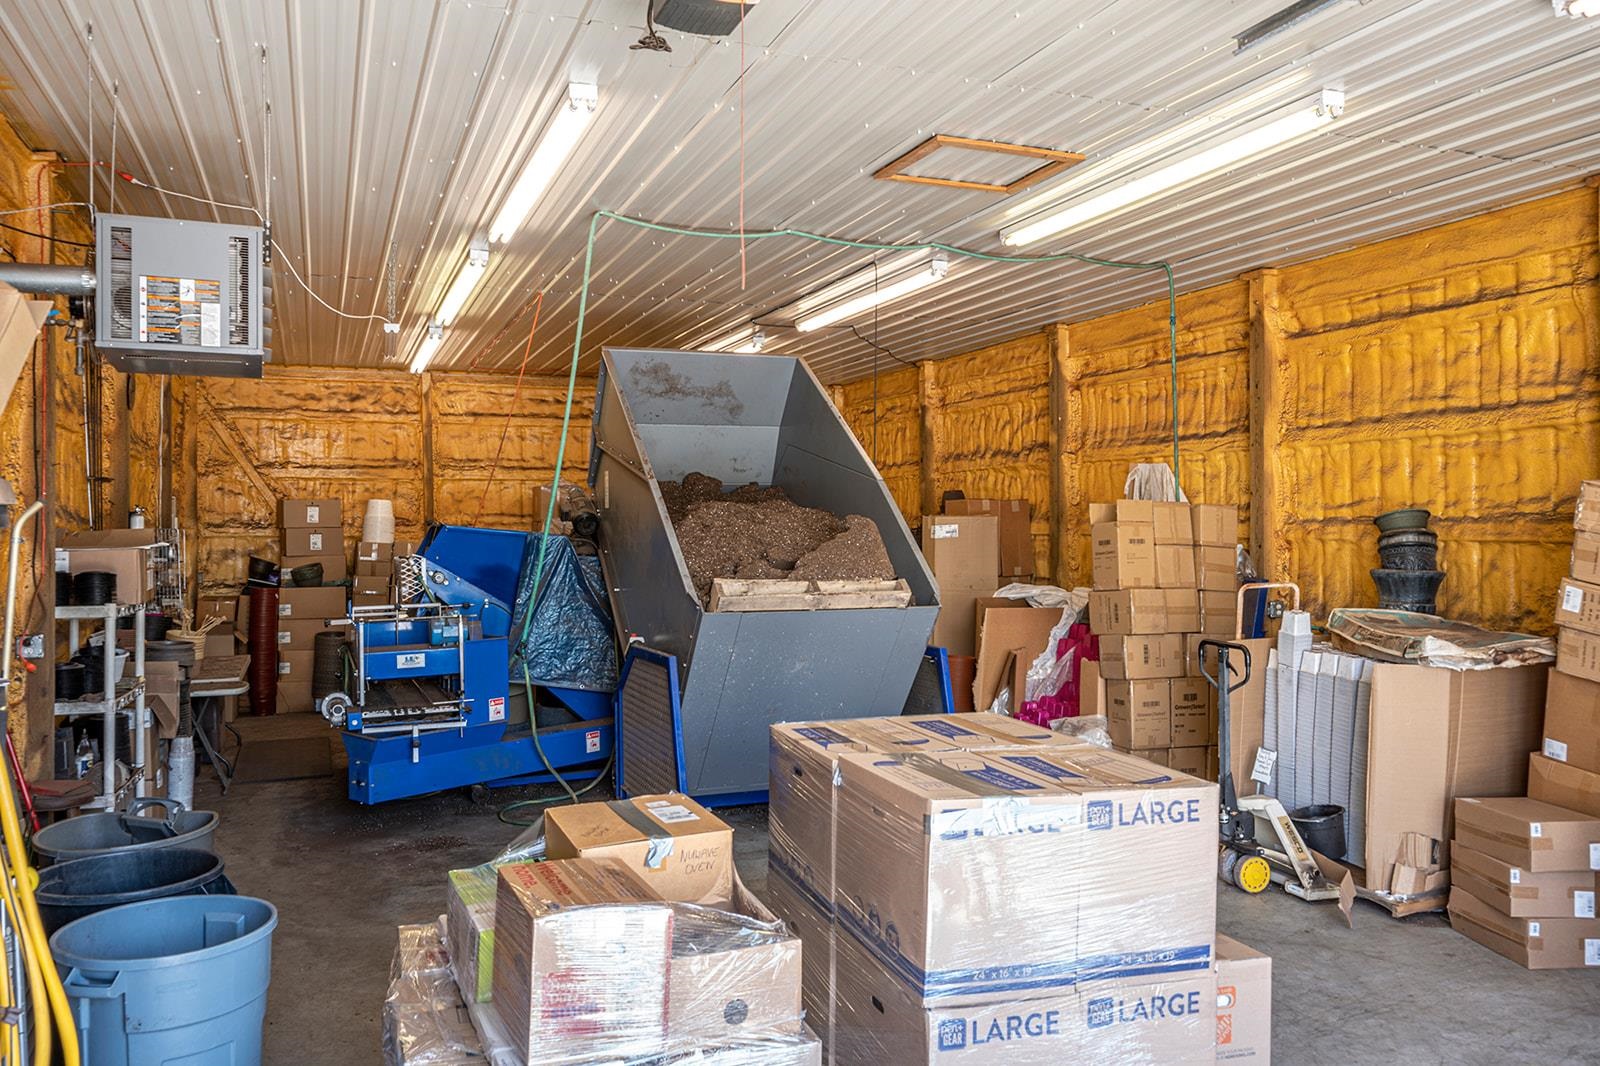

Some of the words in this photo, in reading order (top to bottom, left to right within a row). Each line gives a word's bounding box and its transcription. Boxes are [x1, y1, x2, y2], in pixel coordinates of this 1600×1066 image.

[1118, 799, 1200, 827] LARGE
[680, 846, 720, 864] NUWAVE
[685, 860, 716, 876] OVEN
[1119, 990, 1201, 1023] LARGE
[943, 1032, 963, 1046] GEAR
[972, 1010, 1061, 1045] LARGE
